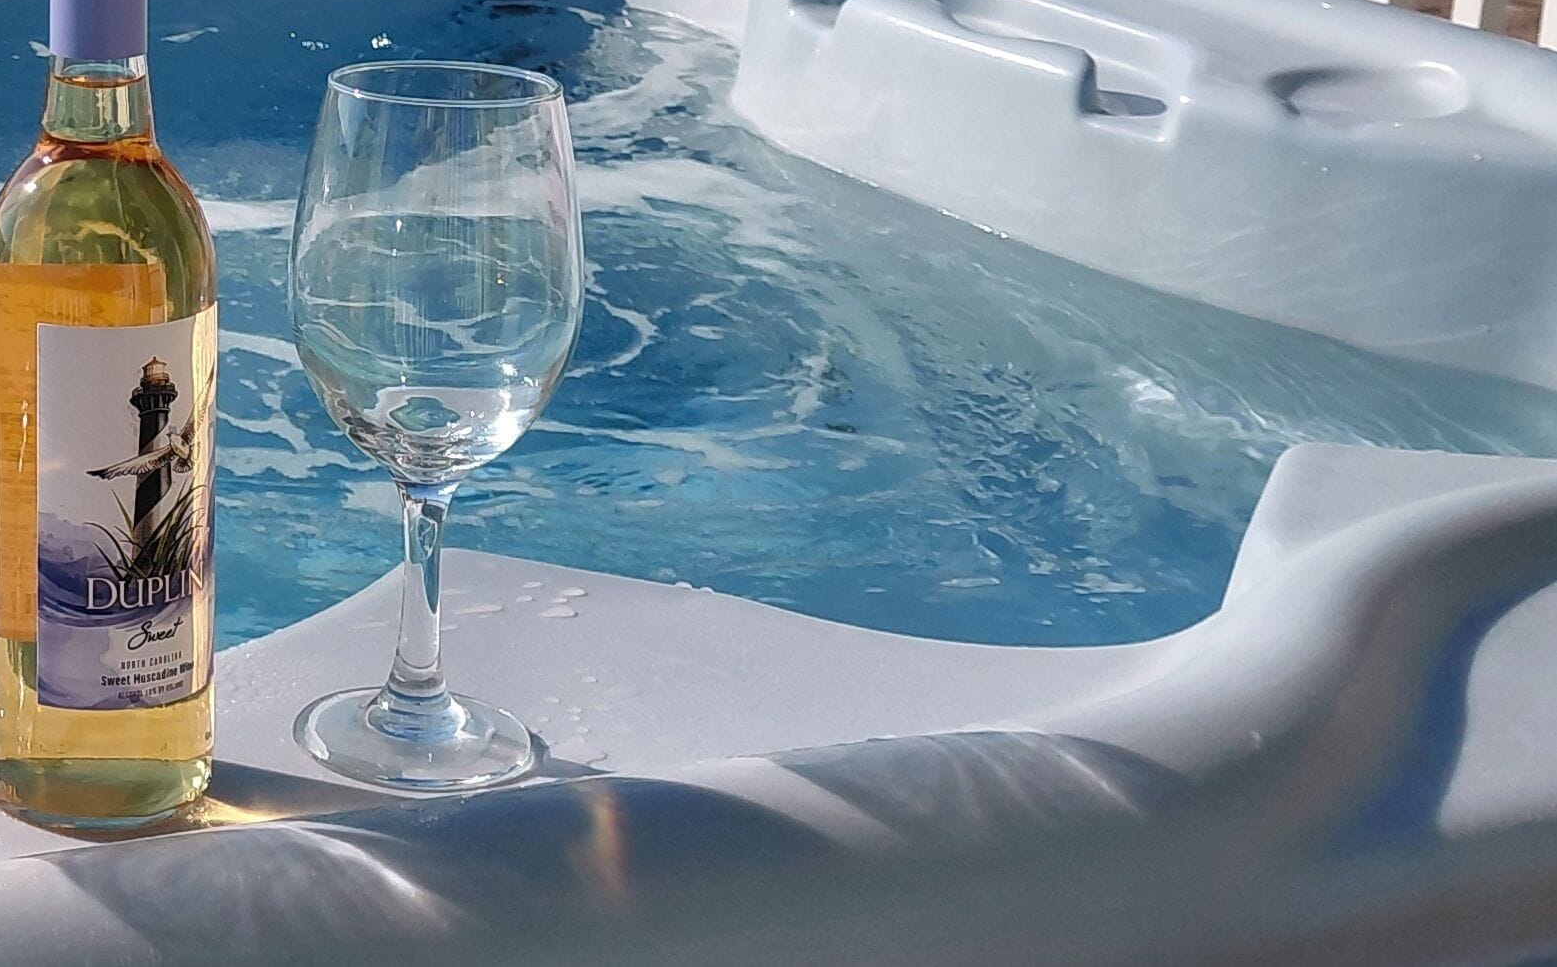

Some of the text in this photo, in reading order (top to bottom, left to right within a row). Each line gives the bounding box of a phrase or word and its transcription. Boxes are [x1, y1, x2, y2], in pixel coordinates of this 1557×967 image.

[86, 561, 204, 610] DUPLIN
[127, 616, 184, 650] Sweet
[120, 650, 182, 670] NORTH CAROLINA
[100, 675, 131, 687] Sweet
[133, 667, 178, 684] Muscadine
